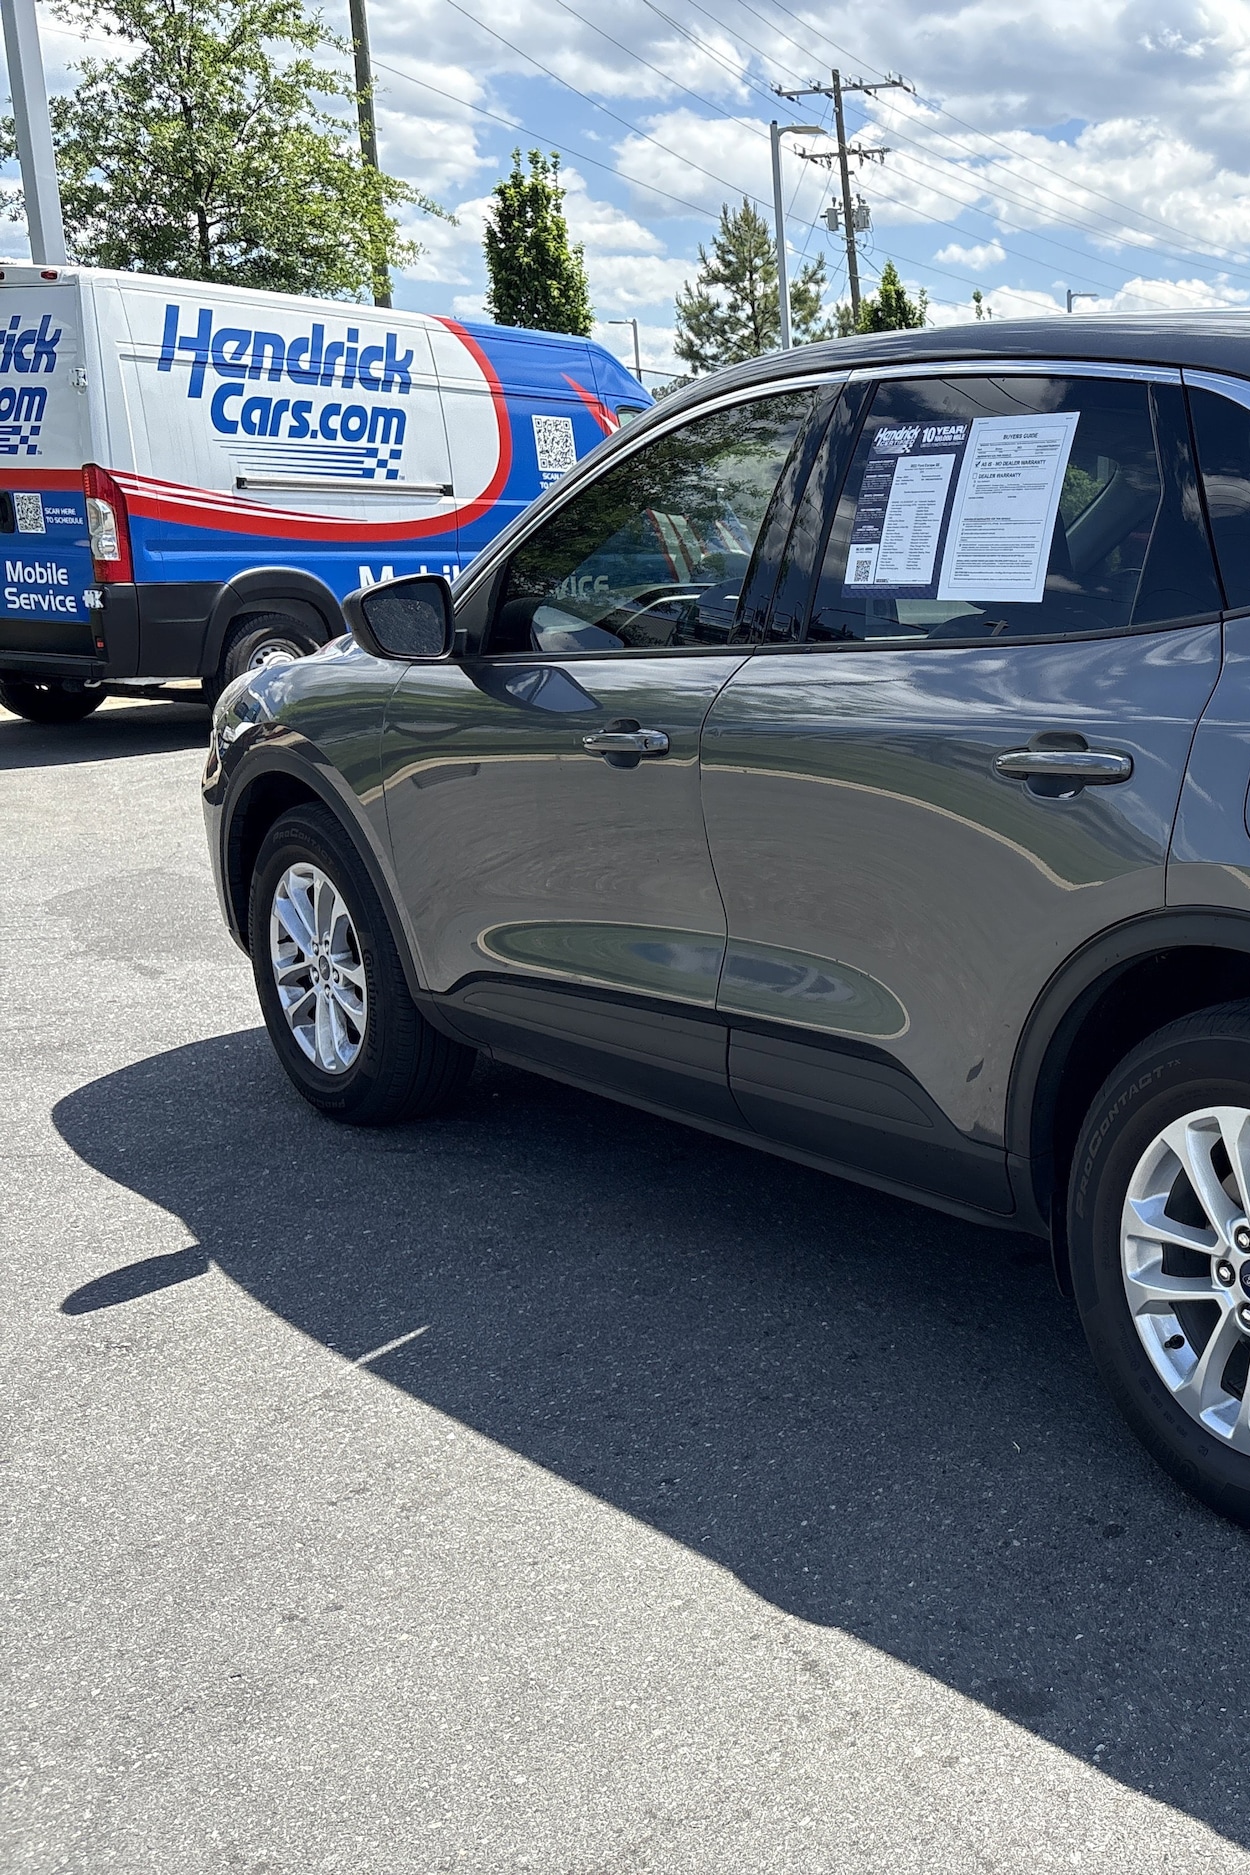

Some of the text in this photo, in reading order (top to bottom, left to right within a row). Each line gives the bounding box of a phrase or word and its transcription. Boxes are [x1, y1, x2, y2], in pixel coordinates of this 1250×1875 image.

[157, 304, 414, 398] Hendrick
[210, 382, 407, 445] Cars.com
[922, 426, 936, 443] 10
[45, 507, 76, 516] SCAN HERE
[55, 516, 84, 525] SCHEDULE
[5, 560, 69, 585] Mobile
[4, 587, 77, 612] Service
